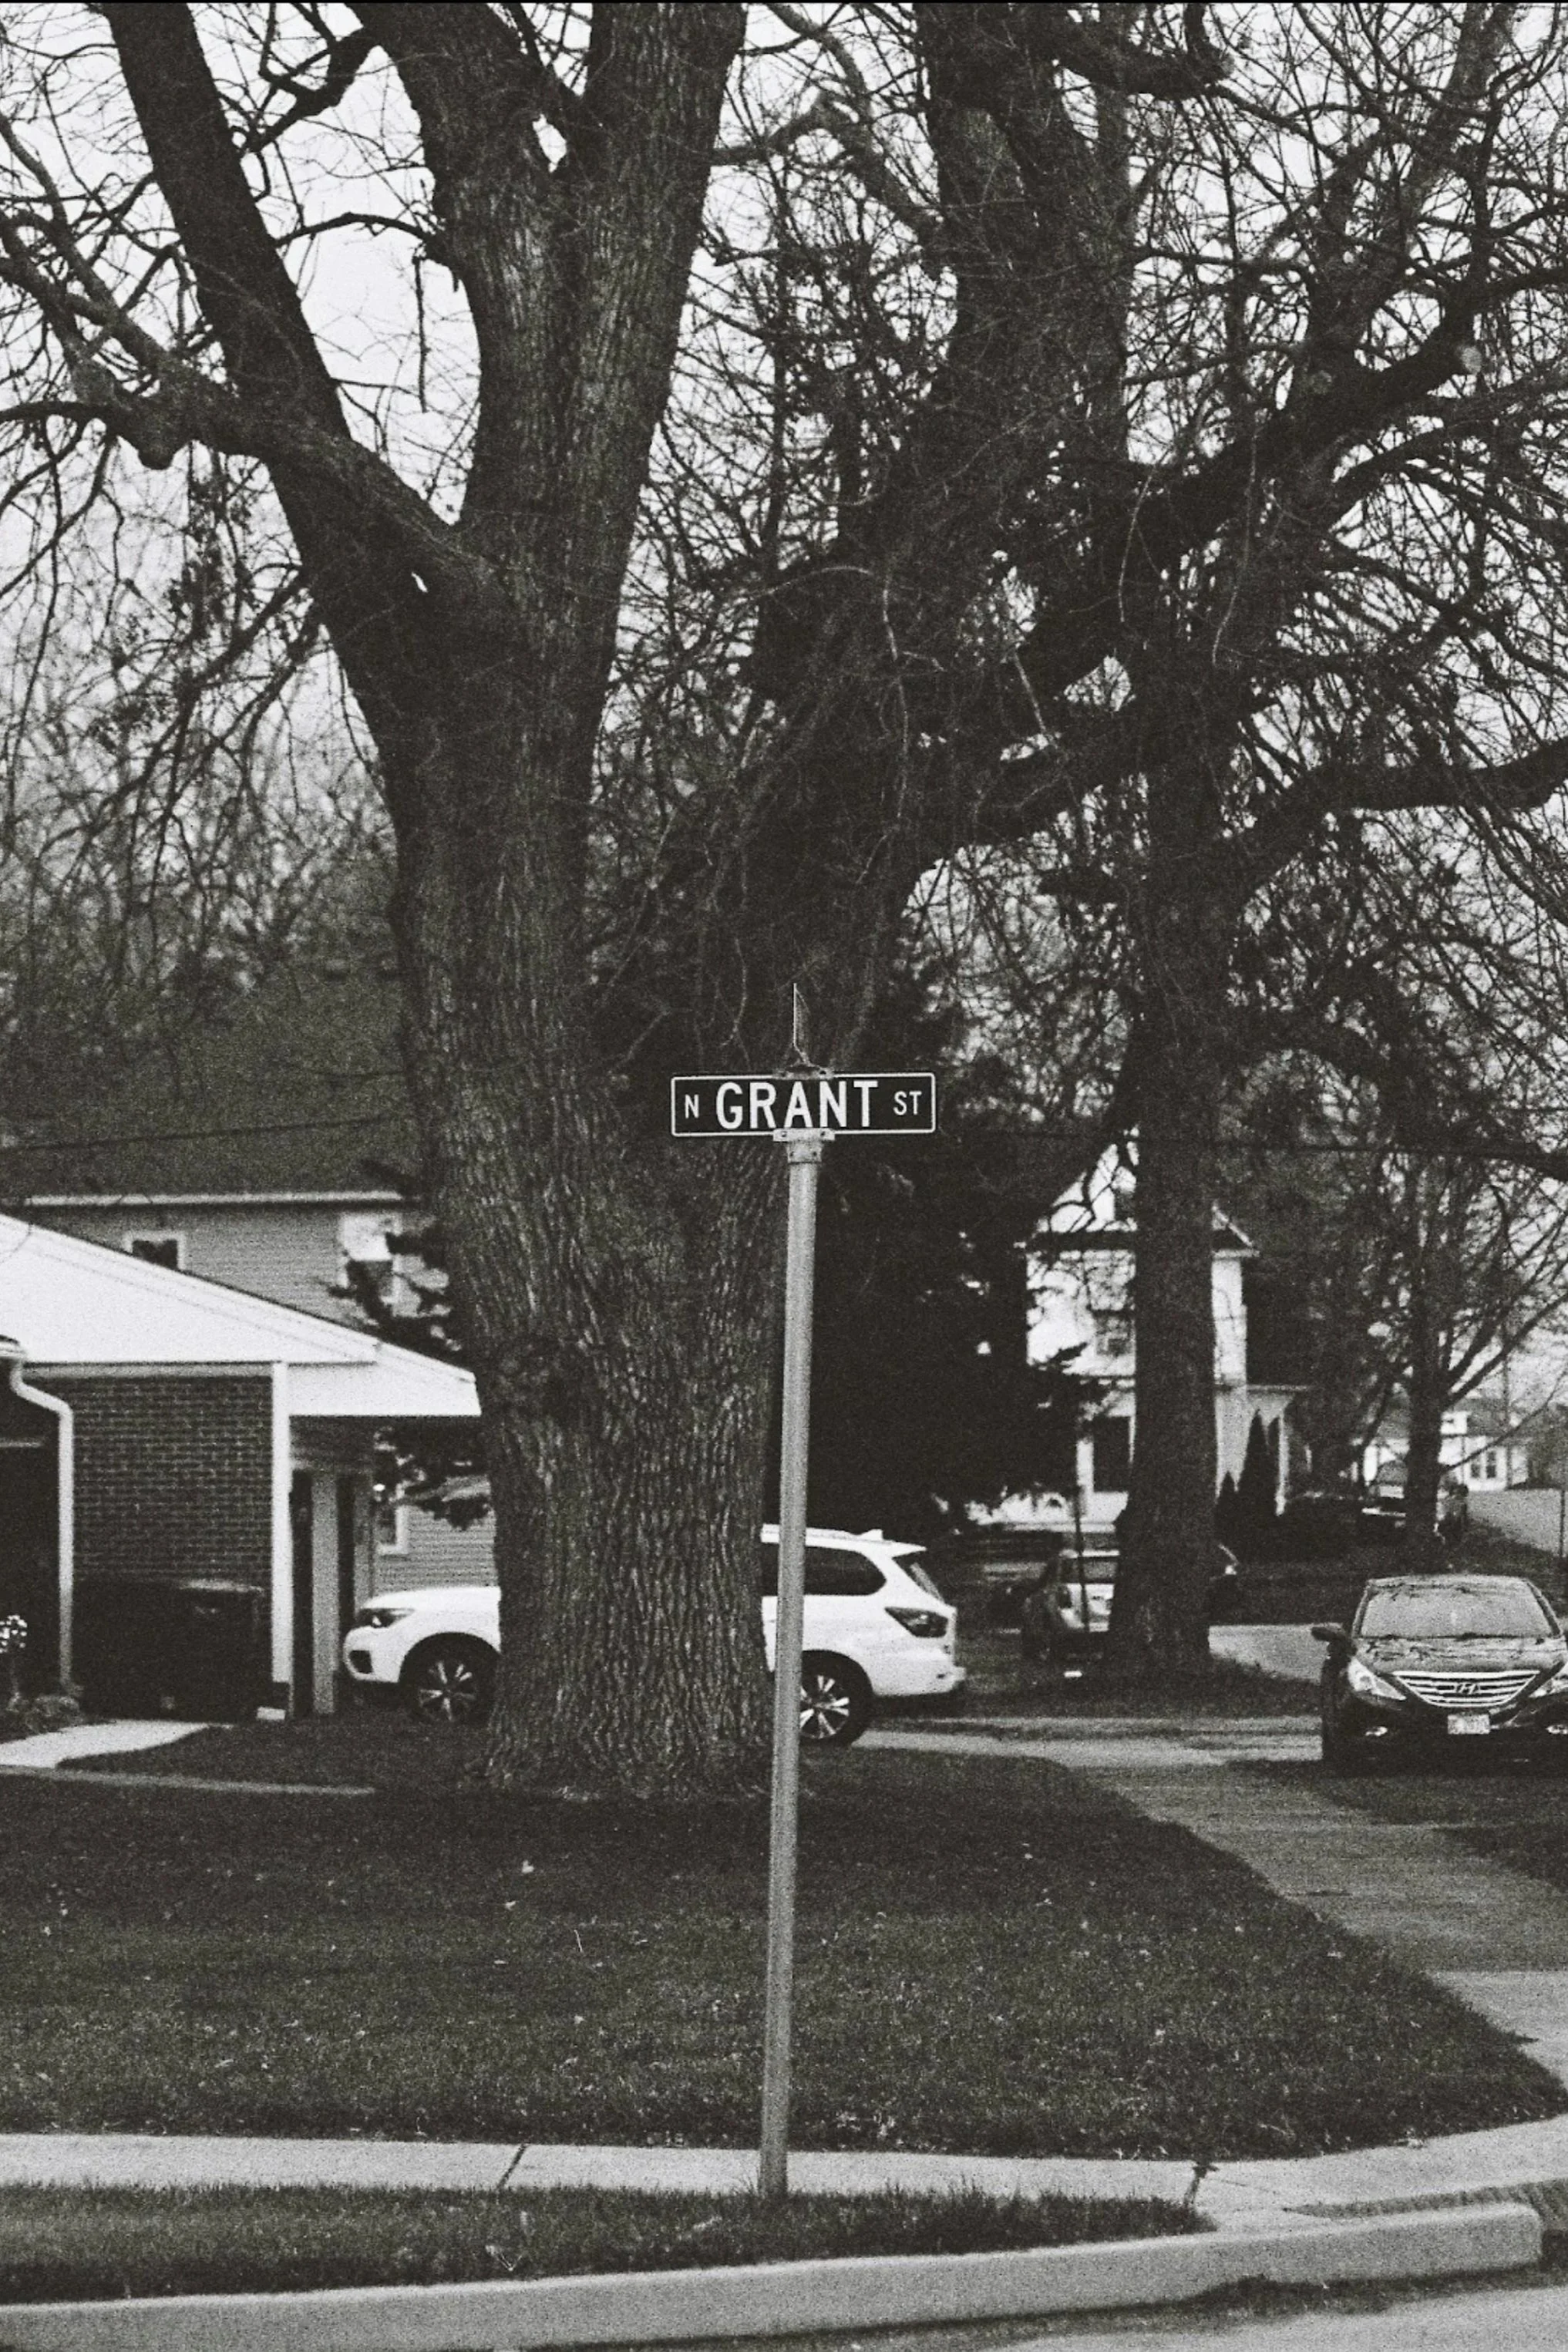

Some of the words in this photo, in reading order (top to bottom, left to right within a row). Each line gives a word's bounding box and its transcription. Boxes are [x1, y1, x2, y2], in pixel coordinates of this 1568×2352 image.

[685, 1094, 699, 1119] N
[715, 1080, 879, 1129] GRANT
[893, 1091, 923, 1116] ST
